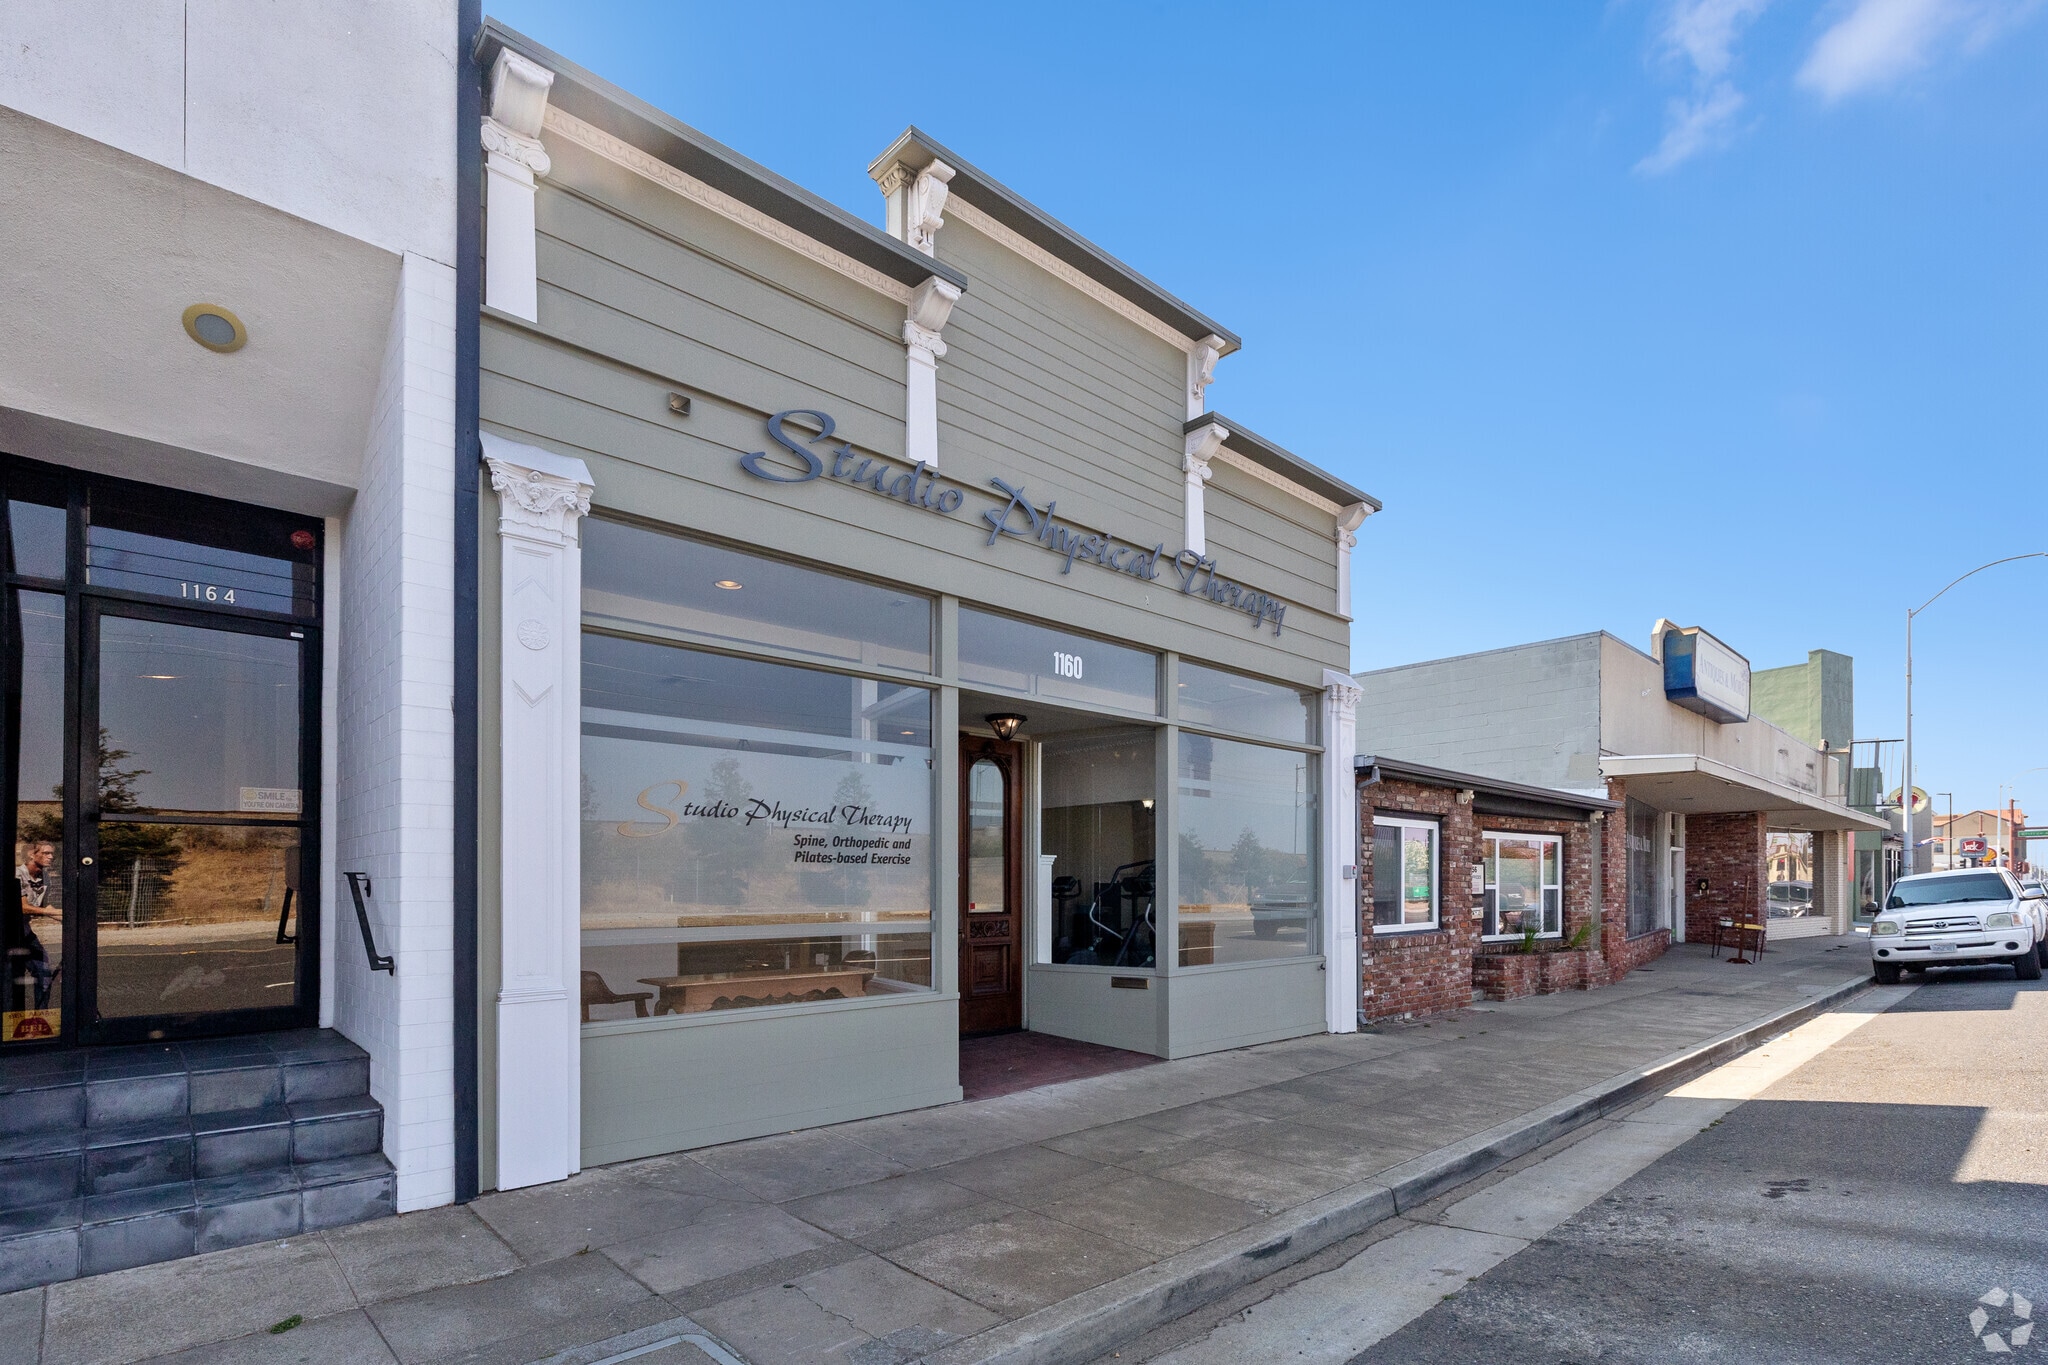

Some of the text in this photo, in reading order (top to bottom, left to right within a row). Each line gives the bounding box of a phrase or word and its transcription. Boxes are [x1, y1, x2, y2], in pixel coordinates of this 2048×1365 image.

[740, 409, 1287, 637] Studio Physical Therapy
[180, 582, 236, 604] 1164
[1053, 651, 1083, 679] 1160
[243, 800, 265, 809] YOU'RE
[265, 801, 274, 809] ON
[258, 791, 286, 801] SMILE
[617, 780, 912, 838] Studio Physical Therapy
[793, 834, 912, 850] Spine, Orthopedic and
[794, 851, 911, 864] Pilates-based Exercise
